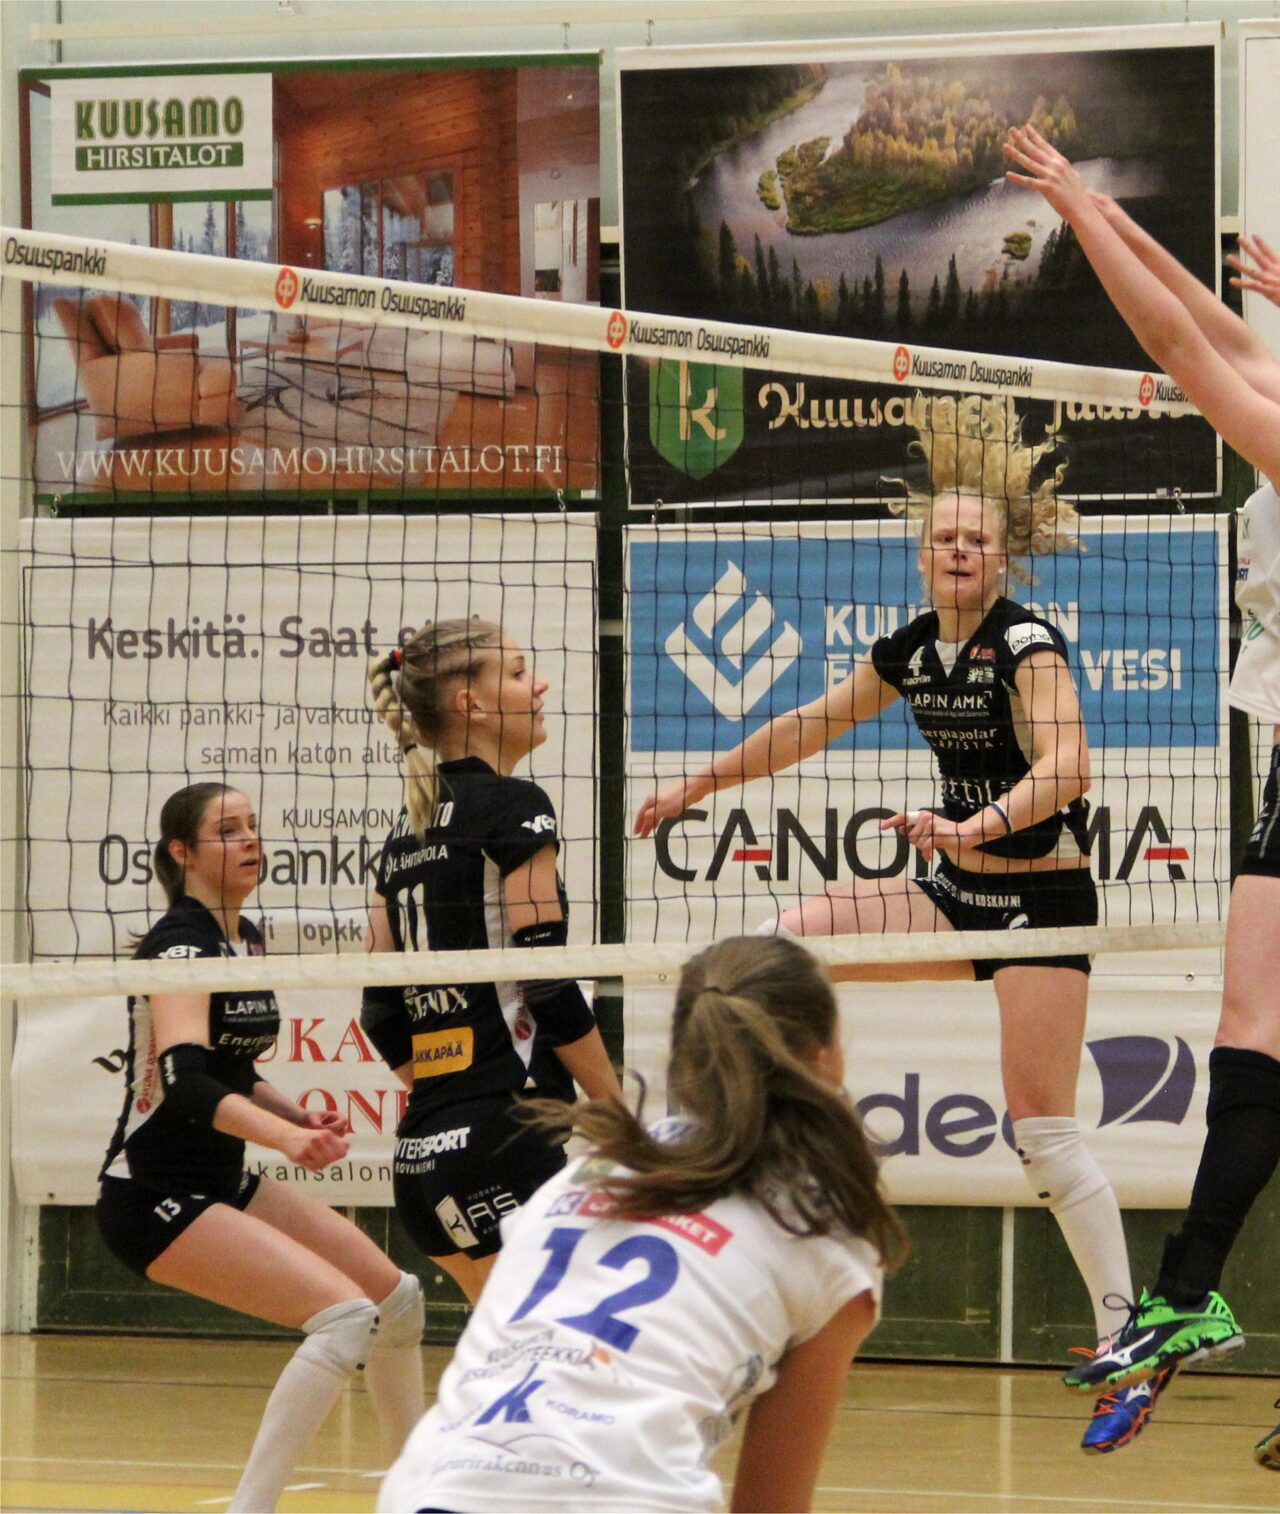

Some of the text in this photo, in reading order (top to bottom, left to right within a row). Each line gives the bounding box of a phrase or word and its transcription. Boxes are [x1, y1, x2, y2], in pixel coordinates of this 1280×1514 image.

[75, 96, 245, 140] KUUSAMO
[87, 145, 232, 168] HIRSITALOT
[4, 237, 107, 277] Osuuspankki
[300, 277, 466, 322] Kuusamon Osuuspankki
[629, 321, 770, 359] Kuusamon Osuuspankki
[911, 354, 1033, 389] Kuusamon Osuuspankki
[58, 445, 563, 479] WWW.KUUSAMOHIRSITALOT.FI
[87, 614, 259, 659] Keskitä.
[279, 616, 380, 659] Saat
[824, 602, 1079, 647] KUUN
[908, 645, 926, 677] 4
[103, 702, 170, 726] Kaikki
[179, 702, 265, 730] pankki-
[274, 702, 296, 730] ja
[908, 693, 987, 709] LAPIN AMK
[920, 728, 997, 740] nergiapolar
[201, 741, 405, 764] saman katon alta
[282, 809, 394, 828] KUUSAMON
[99, 834, 384, 886] Osankk
[654, 806, 1190, 881] CANOA
[413, 1041, 463, 1065] AKKAPÄÄ
[396, 1127, 471, 1159] NTERSPORT
[152, 1198, 182, 1224] 13
[508, 1227, 679, 1353] 12
